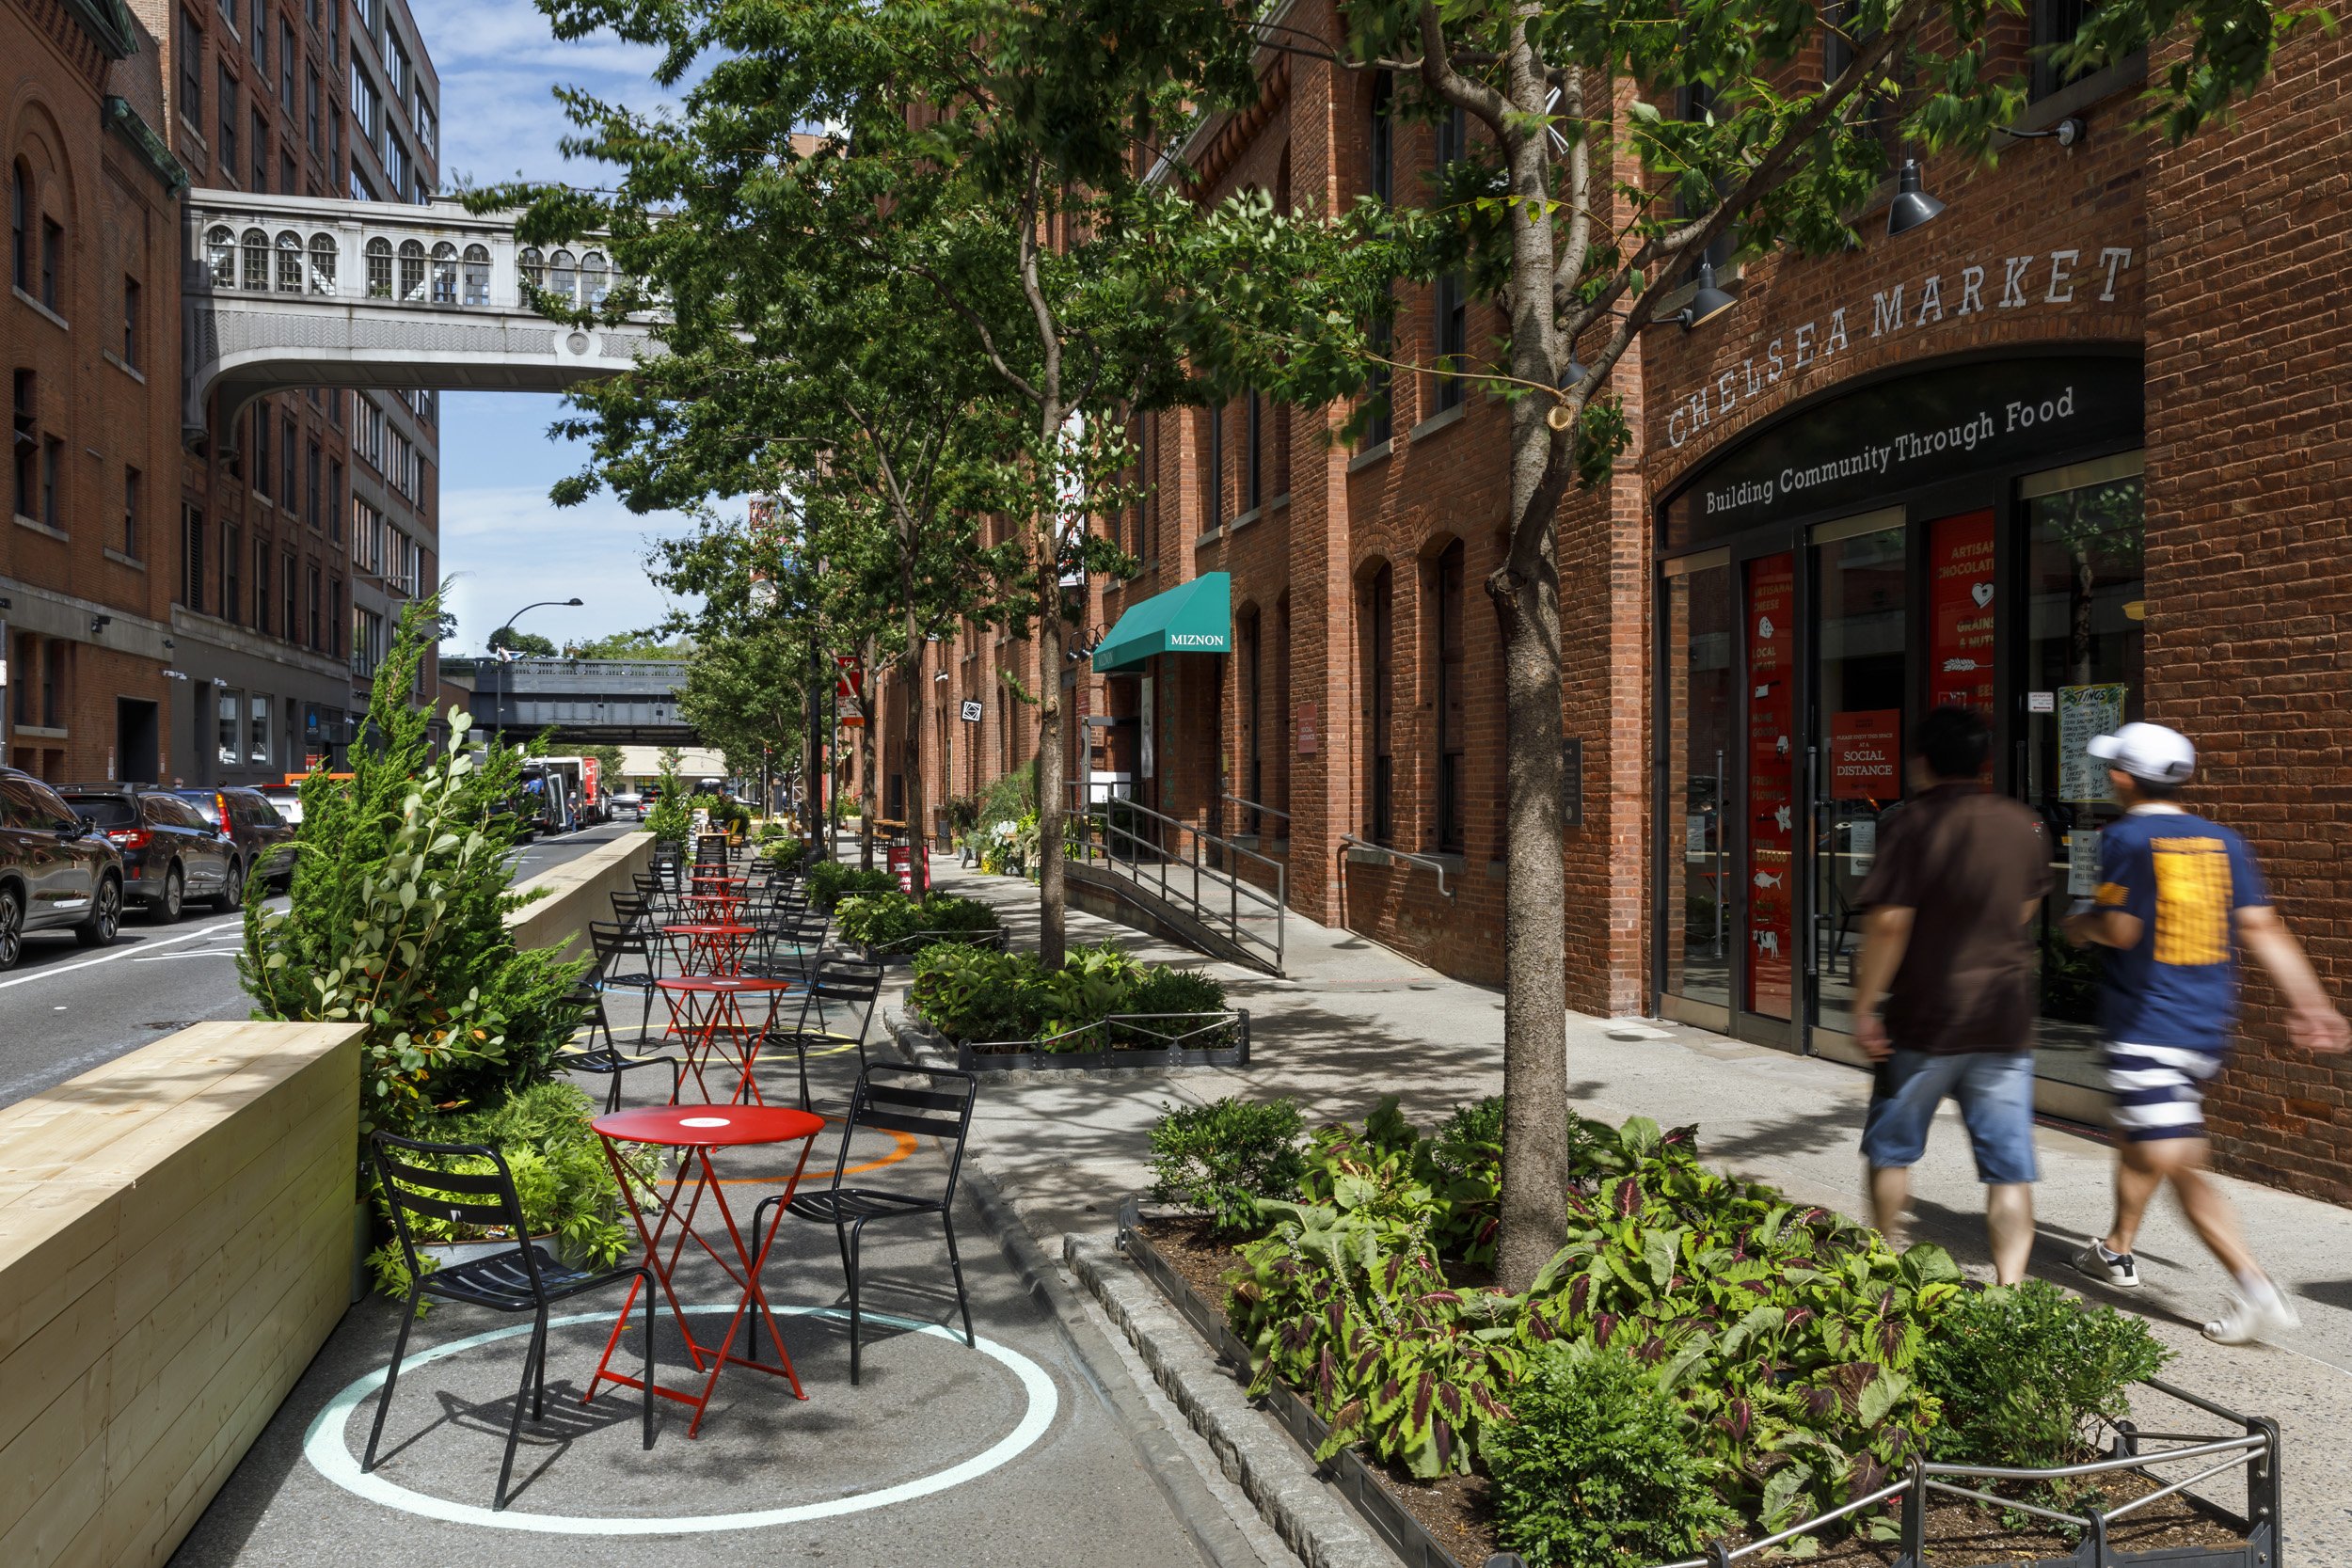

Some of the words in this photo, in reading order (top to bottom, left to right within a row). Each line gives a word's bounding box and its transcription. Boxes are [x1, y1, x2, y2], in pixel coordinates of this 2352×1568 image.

[1668, 307, 1848, 448] CHELSEA
[1870, 247, 2133, 339] MARKET
[1706, 478, 1774, 515] Building
[1780, 445, 1891, 491] Community
[1895, 411, 1994, 462] Through
[2006, 387, 2075, 430] Food
[1170, 634, 1224, 646] MIZNON
[1752, 645, 1776, 658] LOCAL
[2074, 687, 2106, 703] TINGS
[1843, 751, 1885, 762] SOCIAL
[1836, 765, 1893, 776] DISTANCE
[1752, 850, 1788, 863] SEAFOOD
